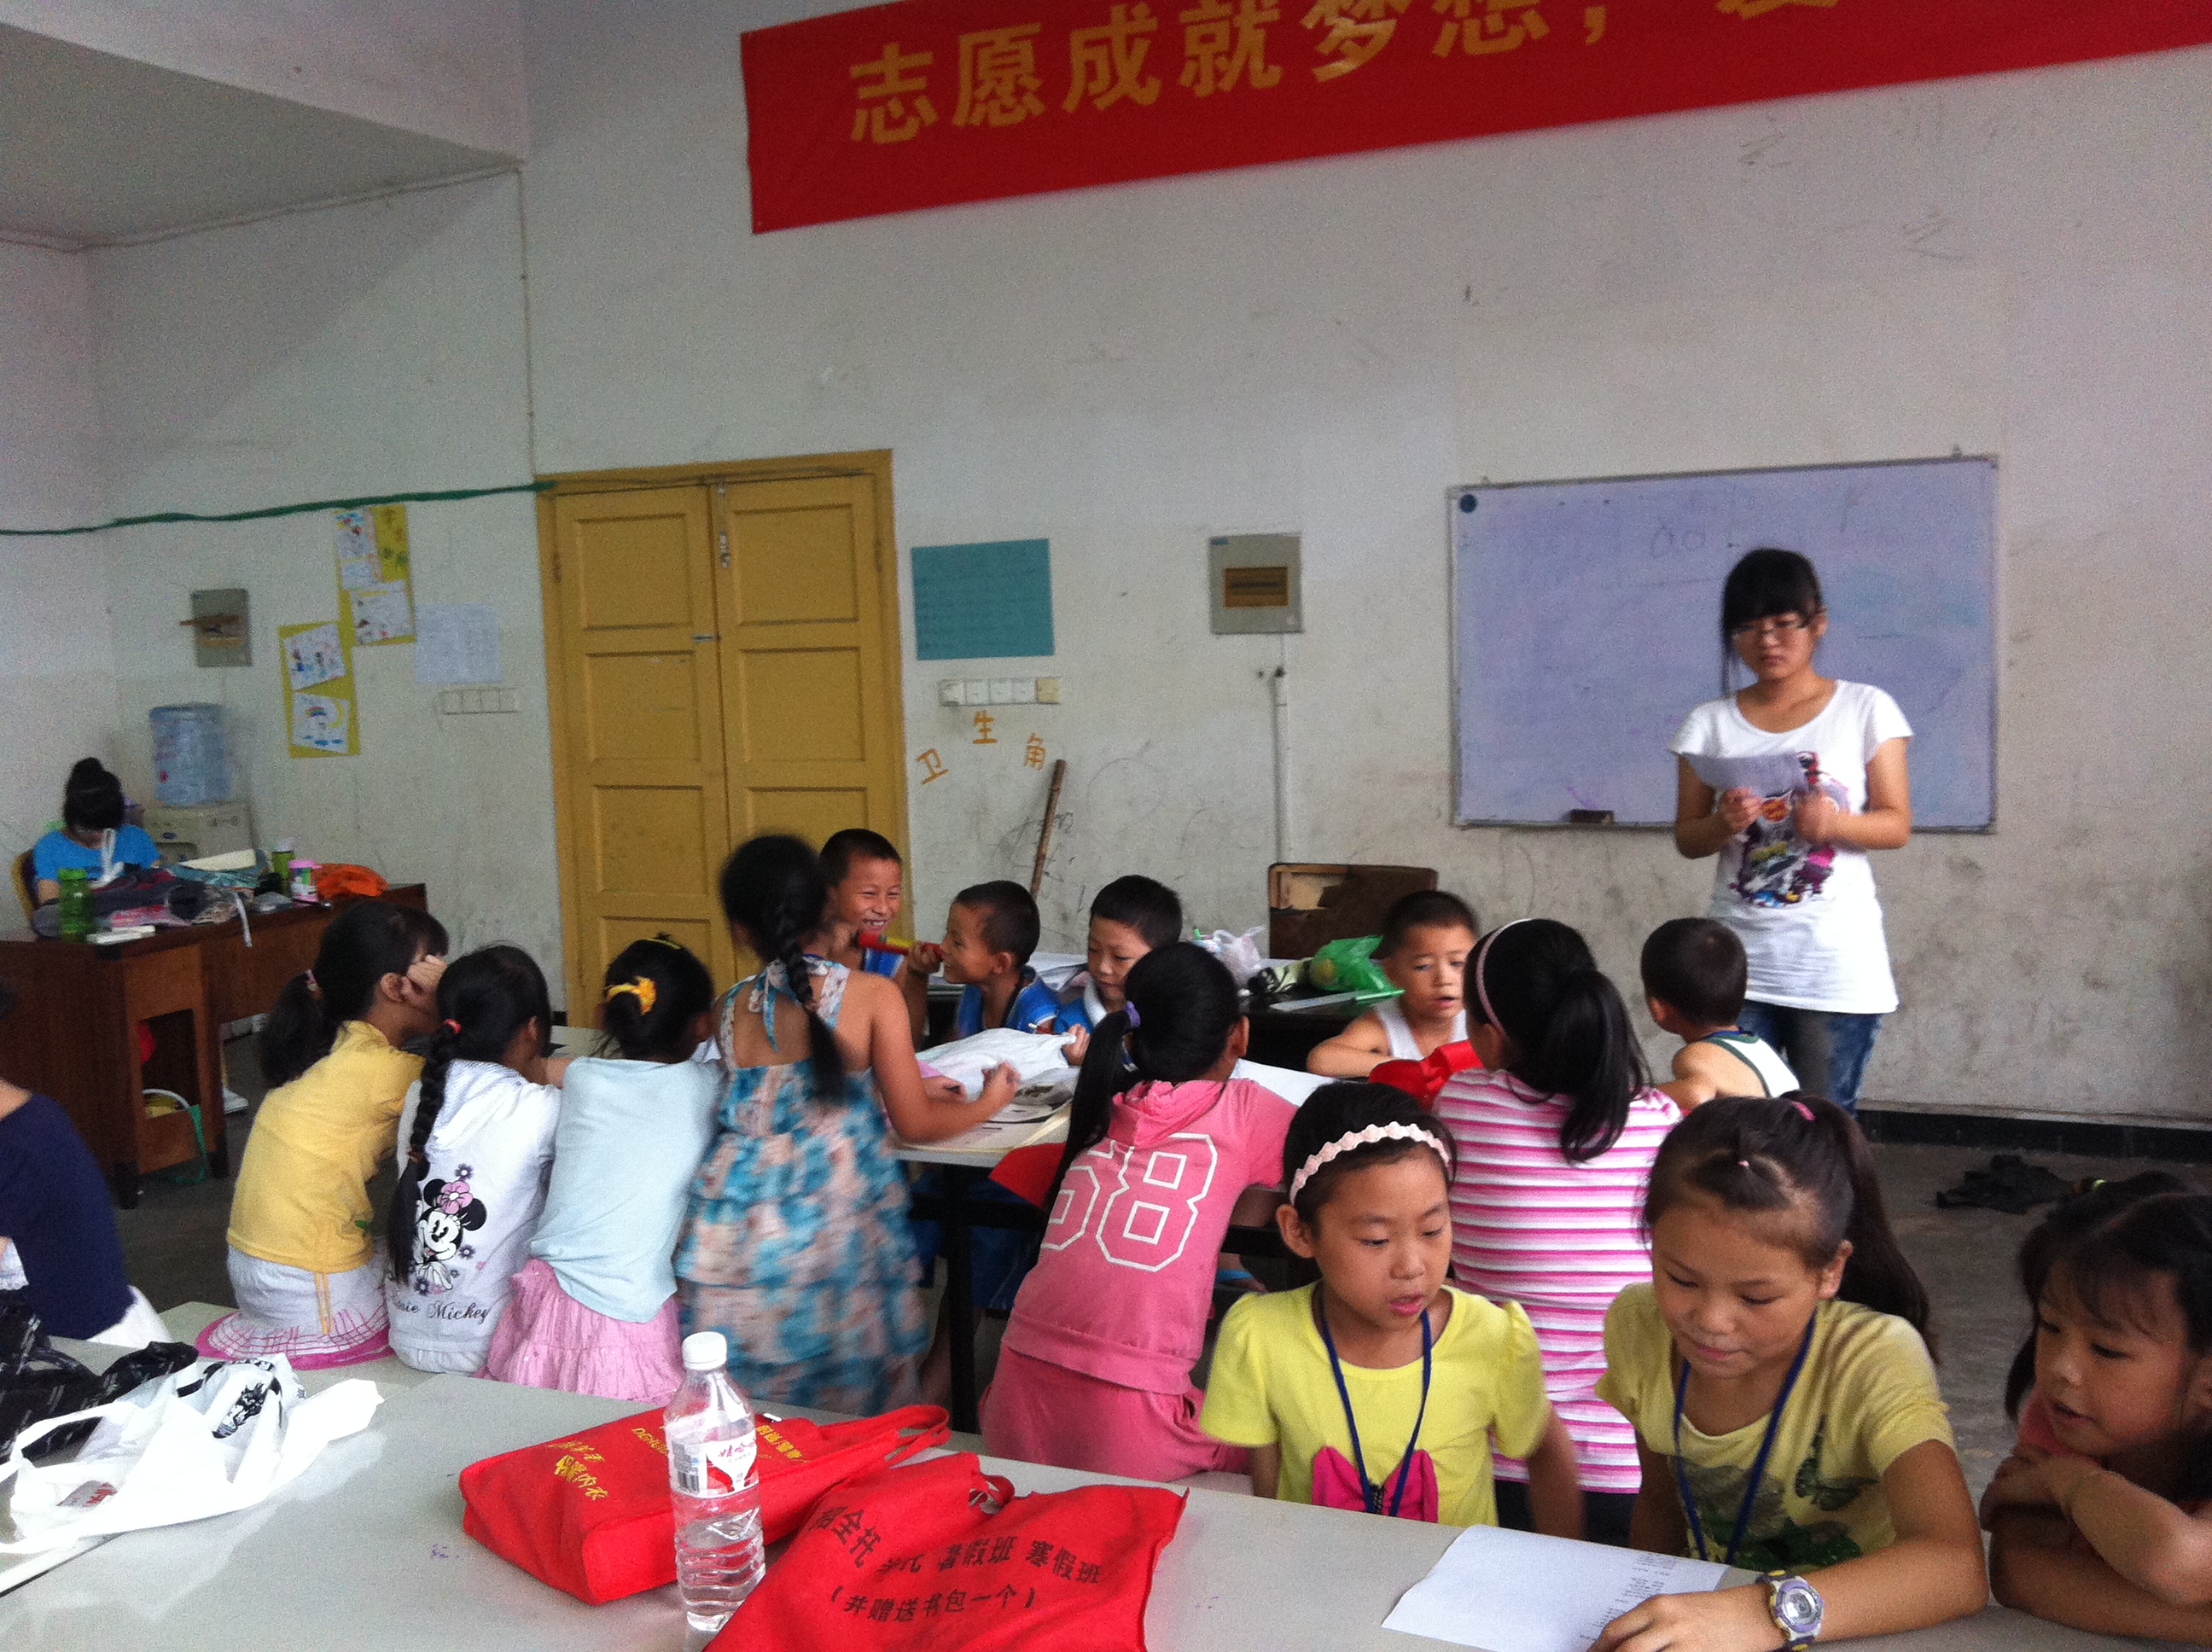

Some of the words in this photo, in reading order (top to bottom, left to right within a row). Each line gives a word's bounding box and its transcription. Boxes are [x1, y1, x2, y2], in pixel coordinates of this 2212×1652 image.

[850, 0, 1845, 143] 志愿成就梦想，
[428, 1300, 491, 1324] Mickey
[939, 1536, 1017, 1572] 暑假班
[1026, 1539, 1103, 1584] 寒假班
